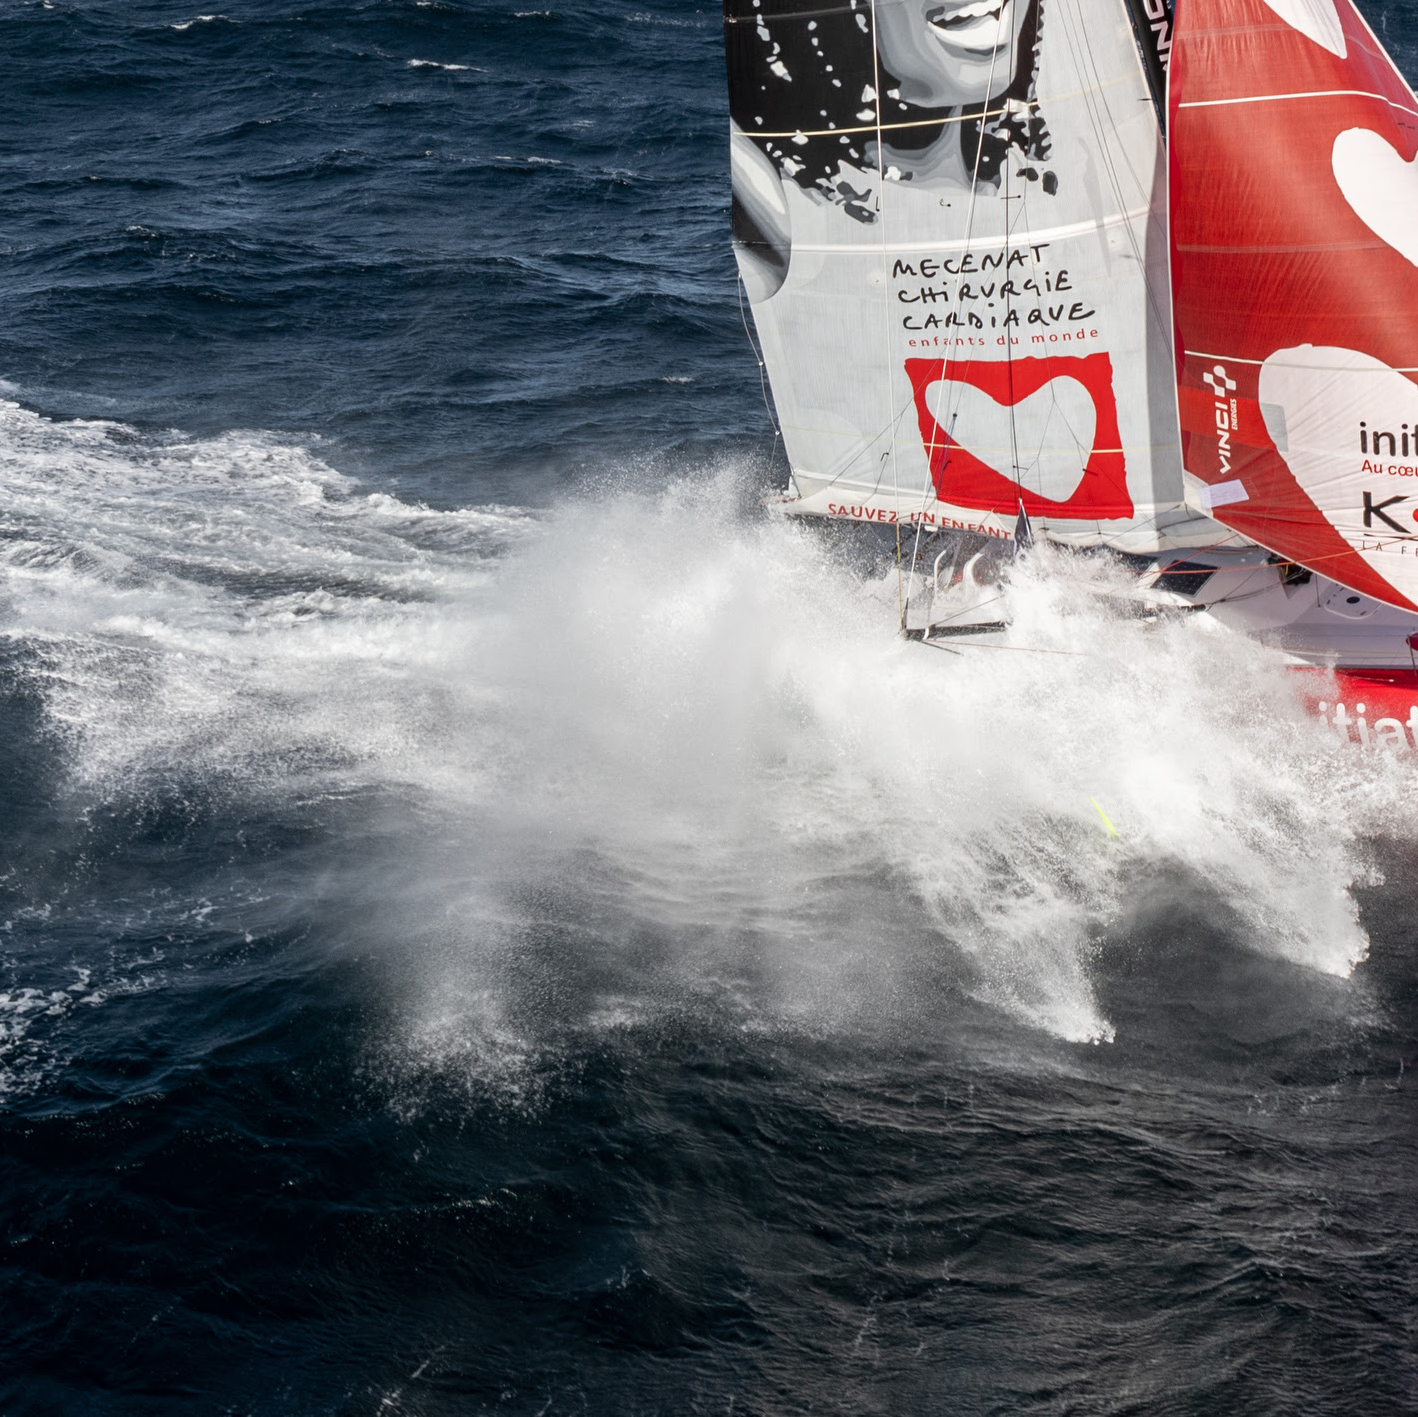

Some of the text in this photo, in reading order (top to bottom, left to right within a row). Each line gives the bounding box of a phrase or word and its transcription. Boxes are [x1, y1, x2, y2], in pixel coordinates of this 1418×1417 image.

[893, 243, 1050, 279] MECENAT
[908, 327, 1100, 348] enfants du monde
[1214, 398, 1239, 475] VINCI ENERGIES
[1361, 459, 1384, 476] Au
[827, 502, 1012, 541] SAUVEZ UN ENFANT
[1362, 539, 1384, 552] LA
